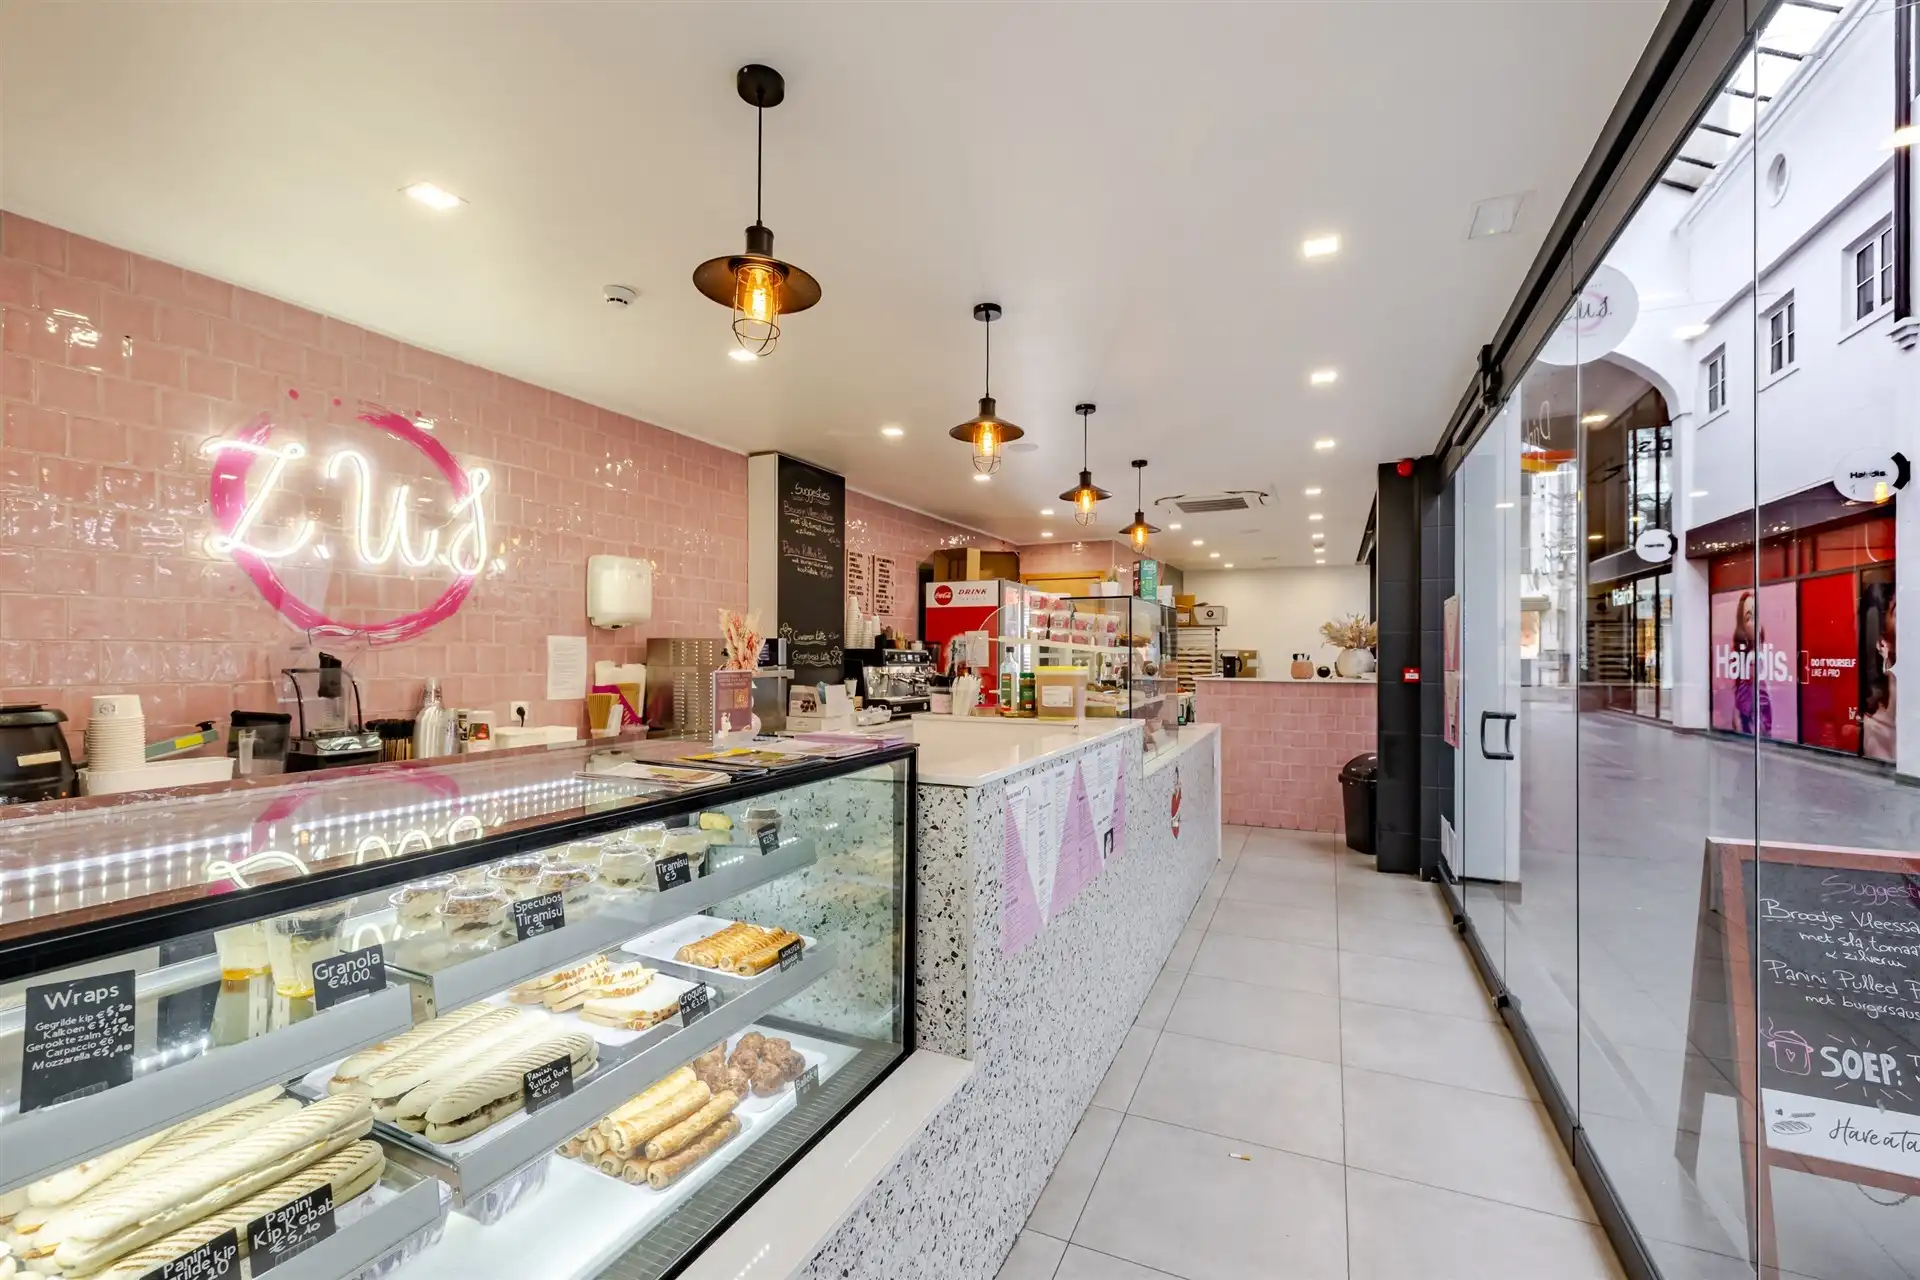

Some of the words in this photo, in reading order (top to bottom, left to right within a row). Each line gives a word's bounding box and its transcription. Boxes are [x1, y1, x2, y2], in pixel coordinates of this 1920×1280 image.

[1715, 643, 1793, 682] Hairdis.
[656, 856, 688, 875] Tiramisu
[664, 869, 677, 882] €3
[515, 893, 562, 914] Speculoos
[1760, 898, 1844, 931] Broodje
[516, 906, 563, 928] Tiramisu
[526, 921, 545, 937] €3
[1799, 931, 1835, 944] met
[314, 950, 381, 981] Granola
[1762, 959, 1827, 985] Panini
[1832, 969, 1899, 994] Pulled
[44, 985, 120, 1010] Wraps
[1805, 994, 1836, 1006] met
[35, 1017, 77, 1031] Gegrilde
[79, 1013, 94, 1023] kip
[43, 1025, 86, 1039] Kalkoen
[26, 1037, 77, 1053] Gerookte
[77, 1031, 102, 1042] zalm
[45, 1041, 97, 1058] Carpaccio
[99, 1037, 114, 1046] €6
[31, 1052, 91, 1071] Mozzarella
[528, 1074, 552, 1090] Pulled
[552, 1066, 569, 1078] Pork
[1829, 1117, 1881, 1146] Have
[1883, 1136, 1900, 1149] a
[265, 1196, 313, 1229] Panini
[253, 1228, 282, 1250] Kip
[285, 1198, 334, 1233] Kebab
[163, 1243, 212, 1279] Panini
[213, 1245, 237, 1264] kip
